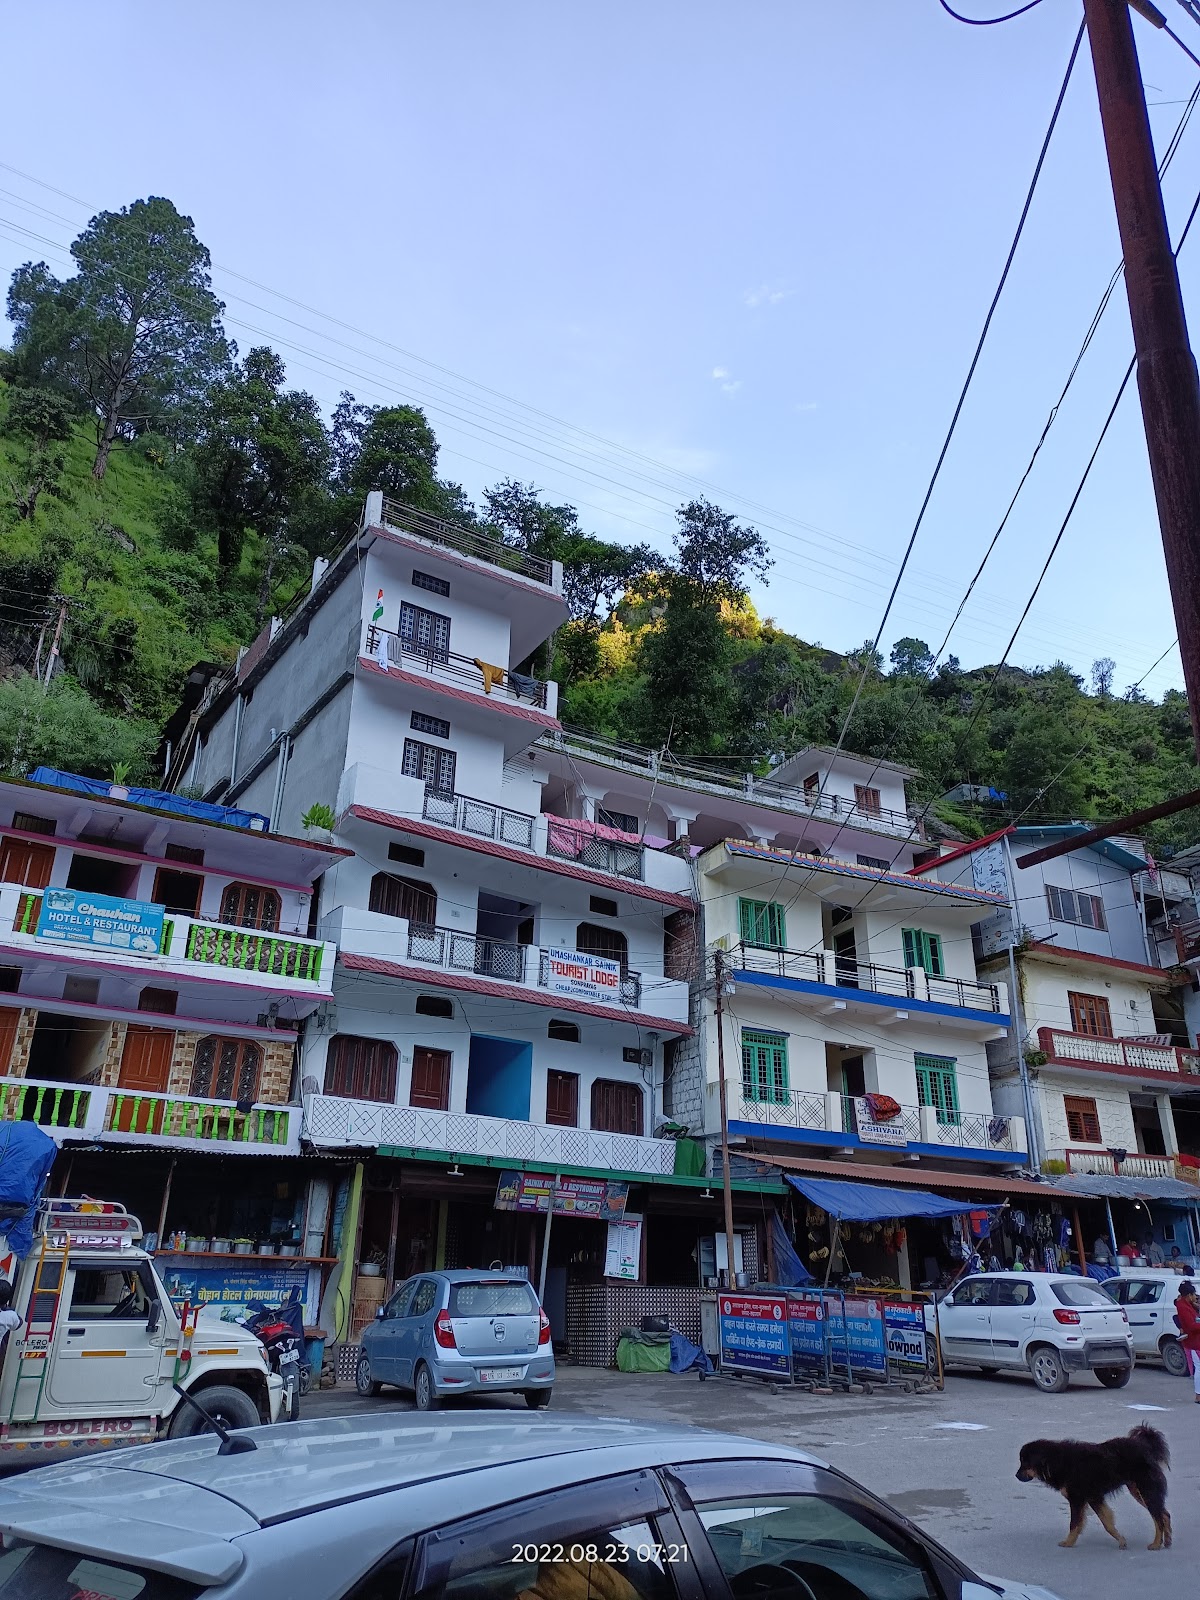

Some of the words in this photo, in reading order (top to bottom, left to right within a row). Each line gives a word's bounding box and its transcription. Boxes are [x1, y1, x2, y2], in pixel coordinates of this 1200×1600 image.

[77, 903, 142, 923] Chauhan
[48, 912, 83, 925] HOTEL
[84, 917, 91, 926] &
[93, 918, 158, 936] RESTAURANT
[550, 948, 593, 967] UMASHANKAR
[595, 959, 617, 972] SAINIK
[549, 960, 589, 980] TOURIST
[590, 969, 619, 987] LODGE
[570, 979, 597, 990] SONPRAYAG
[860, 1125, 904, 1136] ASHIYANA
[524, 1178, 543, 1188] SAINIK
[568, 1183, 605, 1194] RESTAURANT
[60, 1219, 122, 1228] SUPER
[197, 1287, 221, 1301] चौहान
[222, 1287, 242, 1301] होटल
[244, 1287, 279, 1301] सोनप्रयाग
[280, 1288, 303, 1302] (लॉ)
[15, 1339, 48, 1347] BOLERO
[43, 1419, 133, 1436] BOLERO
